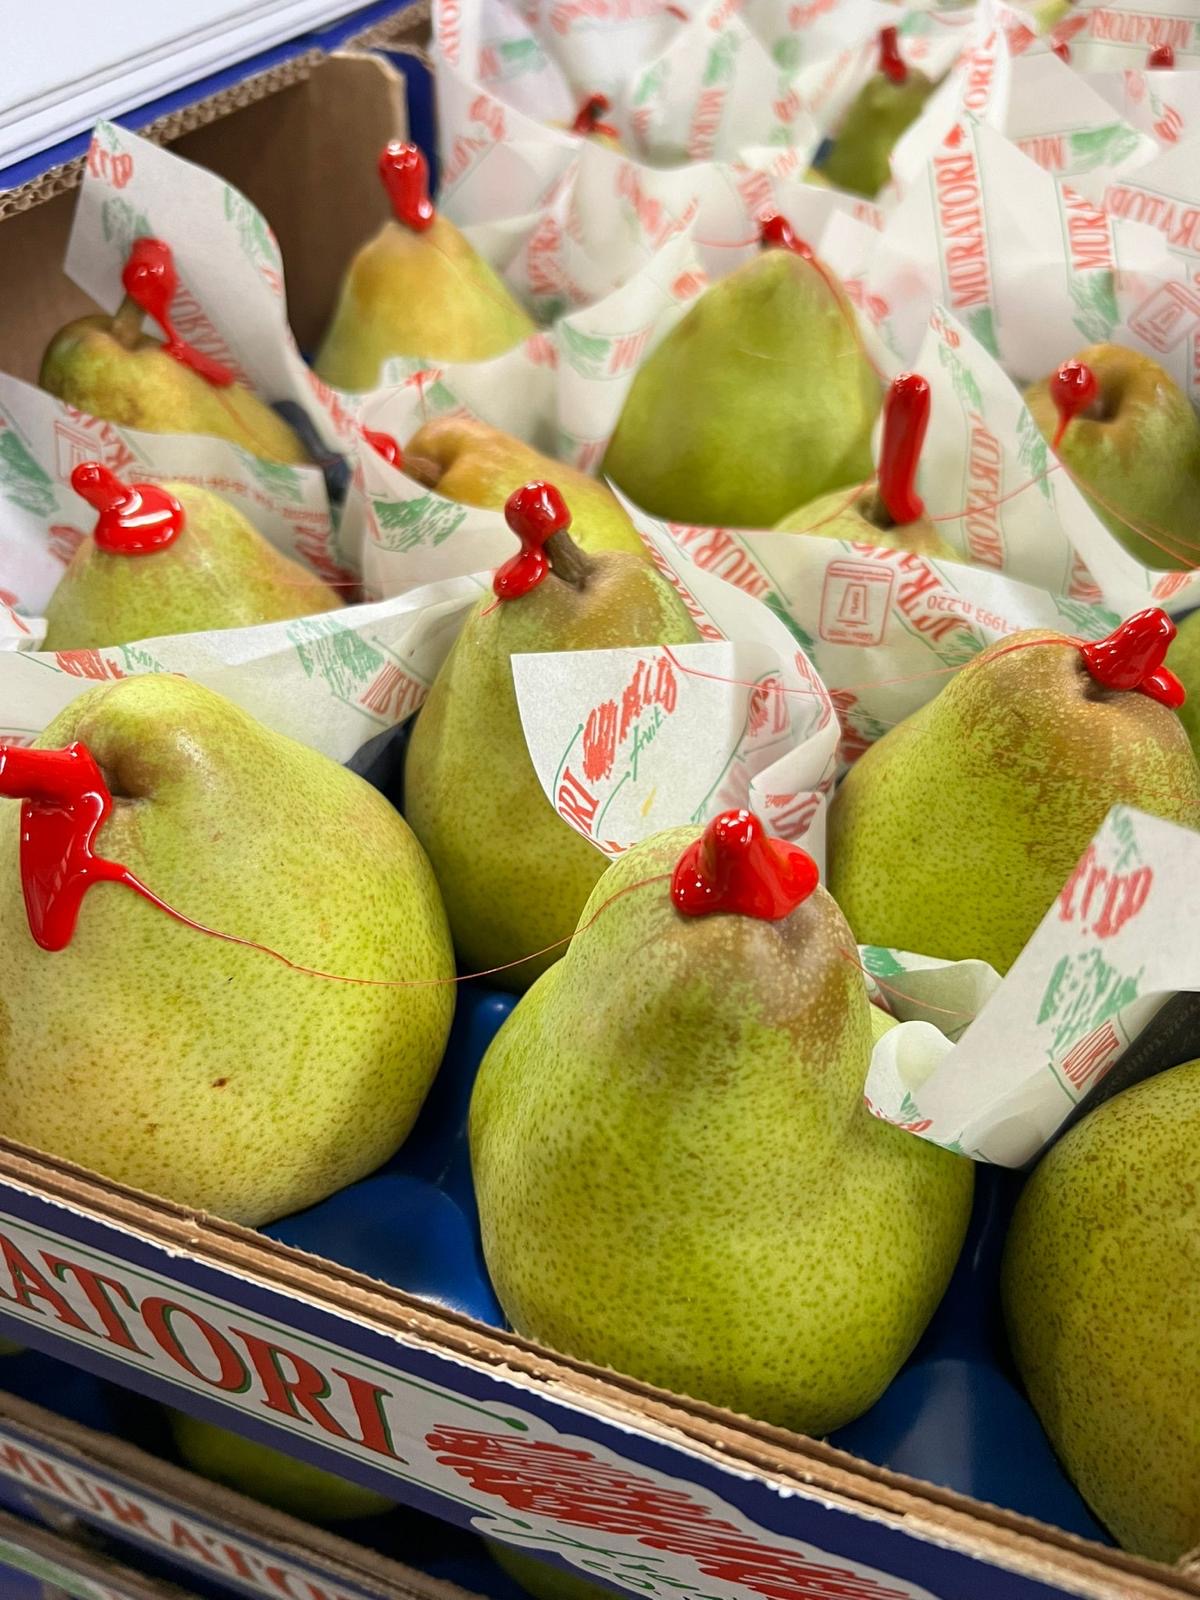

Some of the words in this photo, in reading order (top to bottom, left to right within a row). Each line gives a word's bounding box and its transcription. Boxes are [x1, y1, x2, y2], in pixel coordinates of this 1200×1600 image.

[932, 151, 991, 309] MURATORI
[0, 1232, 409, 1464] ATORI
[490, 1528, 718, 1600] fru
